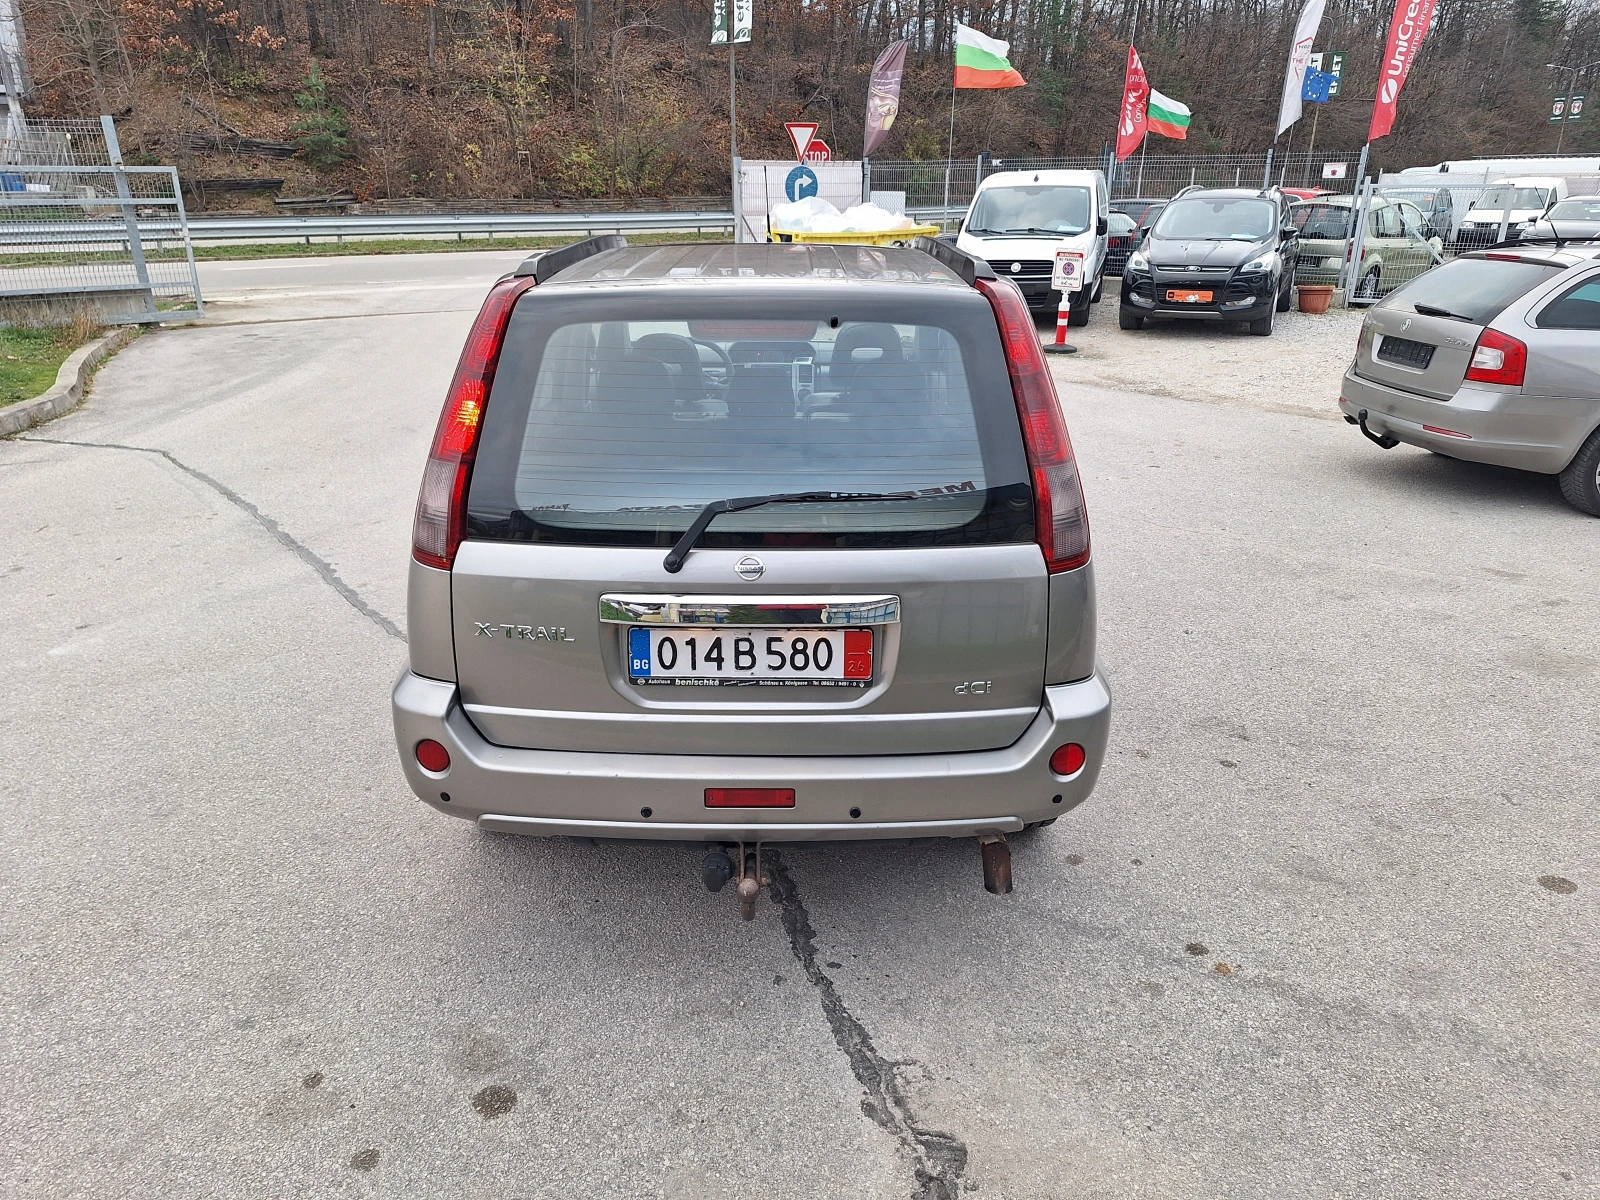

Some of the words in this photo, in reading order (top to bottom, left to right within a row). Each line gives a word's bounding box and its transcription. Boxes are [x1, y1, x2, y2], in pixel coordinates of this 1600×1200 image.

[1387, 0, 1421, 76] UniCre
[474, 622, 576, 642] X-TRAIL
[633, 659, 649, 670] BG
[954, 681, 992, 695] dCi
